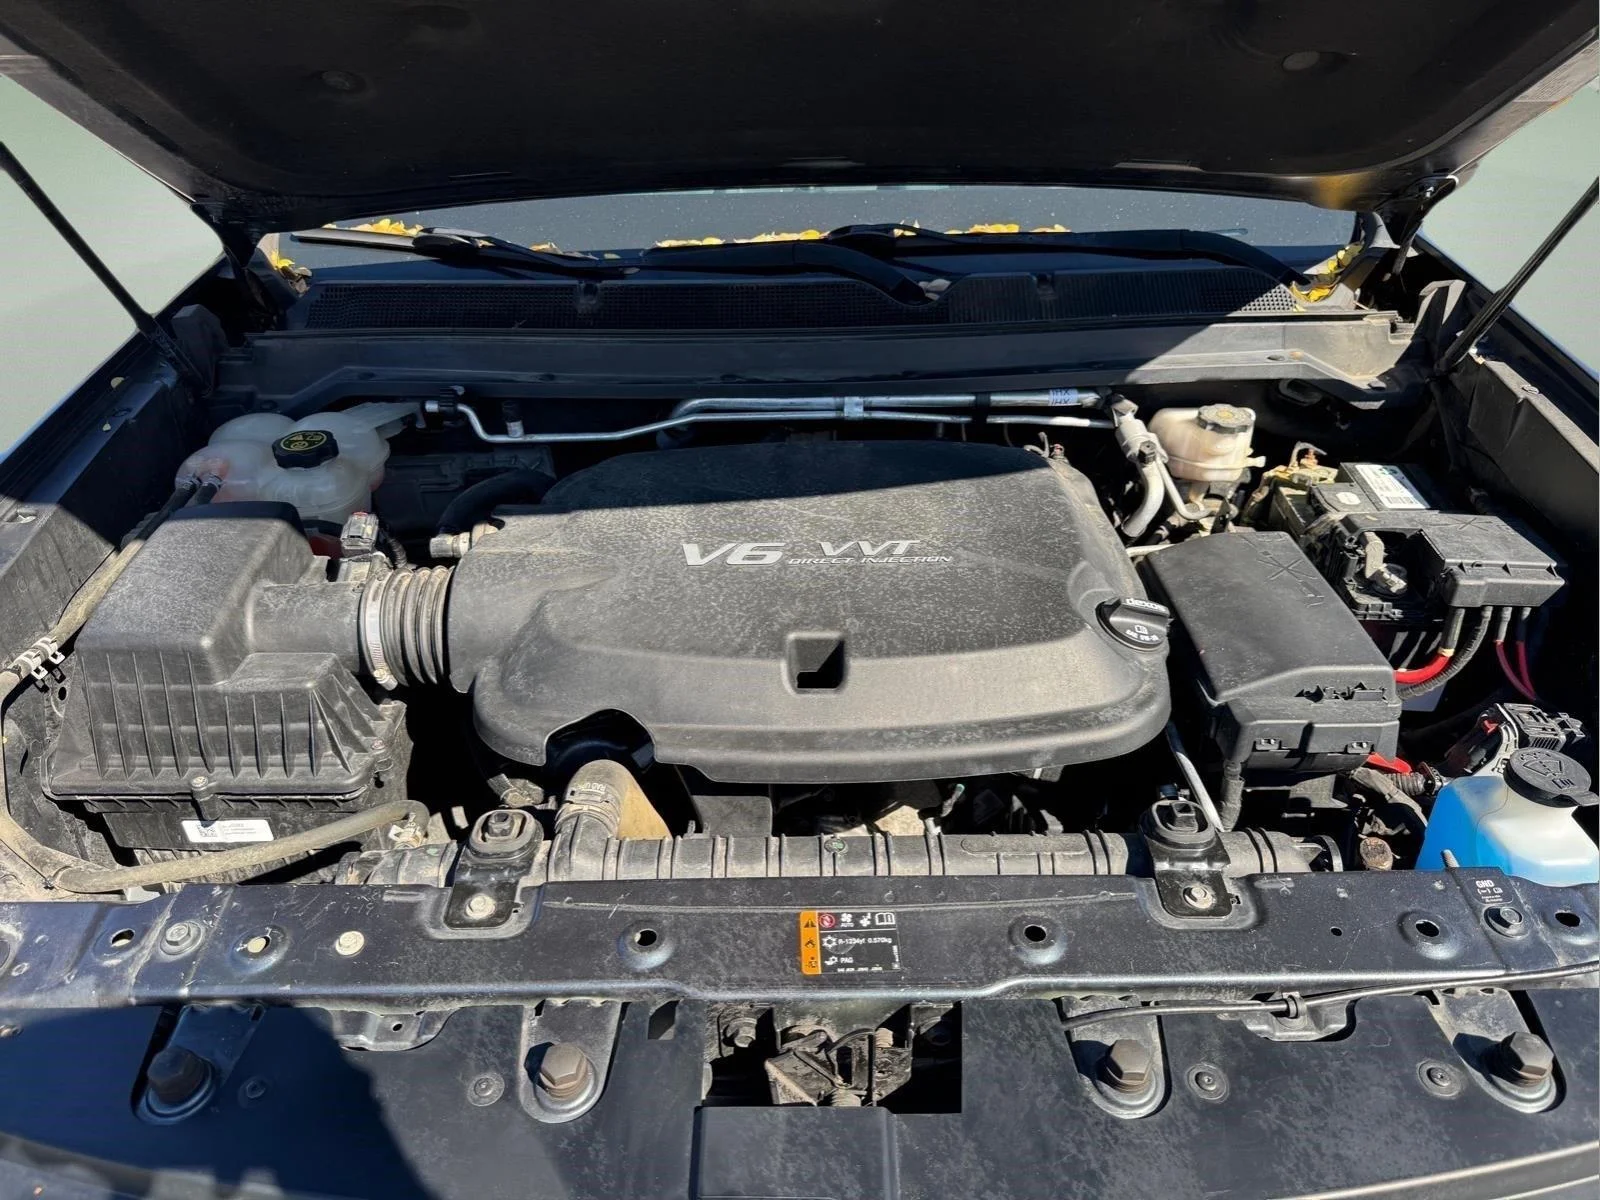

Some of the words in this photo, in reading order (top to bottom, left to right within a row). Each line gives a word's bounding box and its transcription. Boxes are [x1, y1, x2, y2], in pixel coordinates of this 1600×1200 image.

[682, 542, 786, 566] V6
[818, 540, 921, 556] VVT
[788, 557, 855, 566] DIRECT
[860, 556, 953, 565] INJECTION
[1475, 879, 1495, 888] GND
[840, 956, 854, 964] PAG
